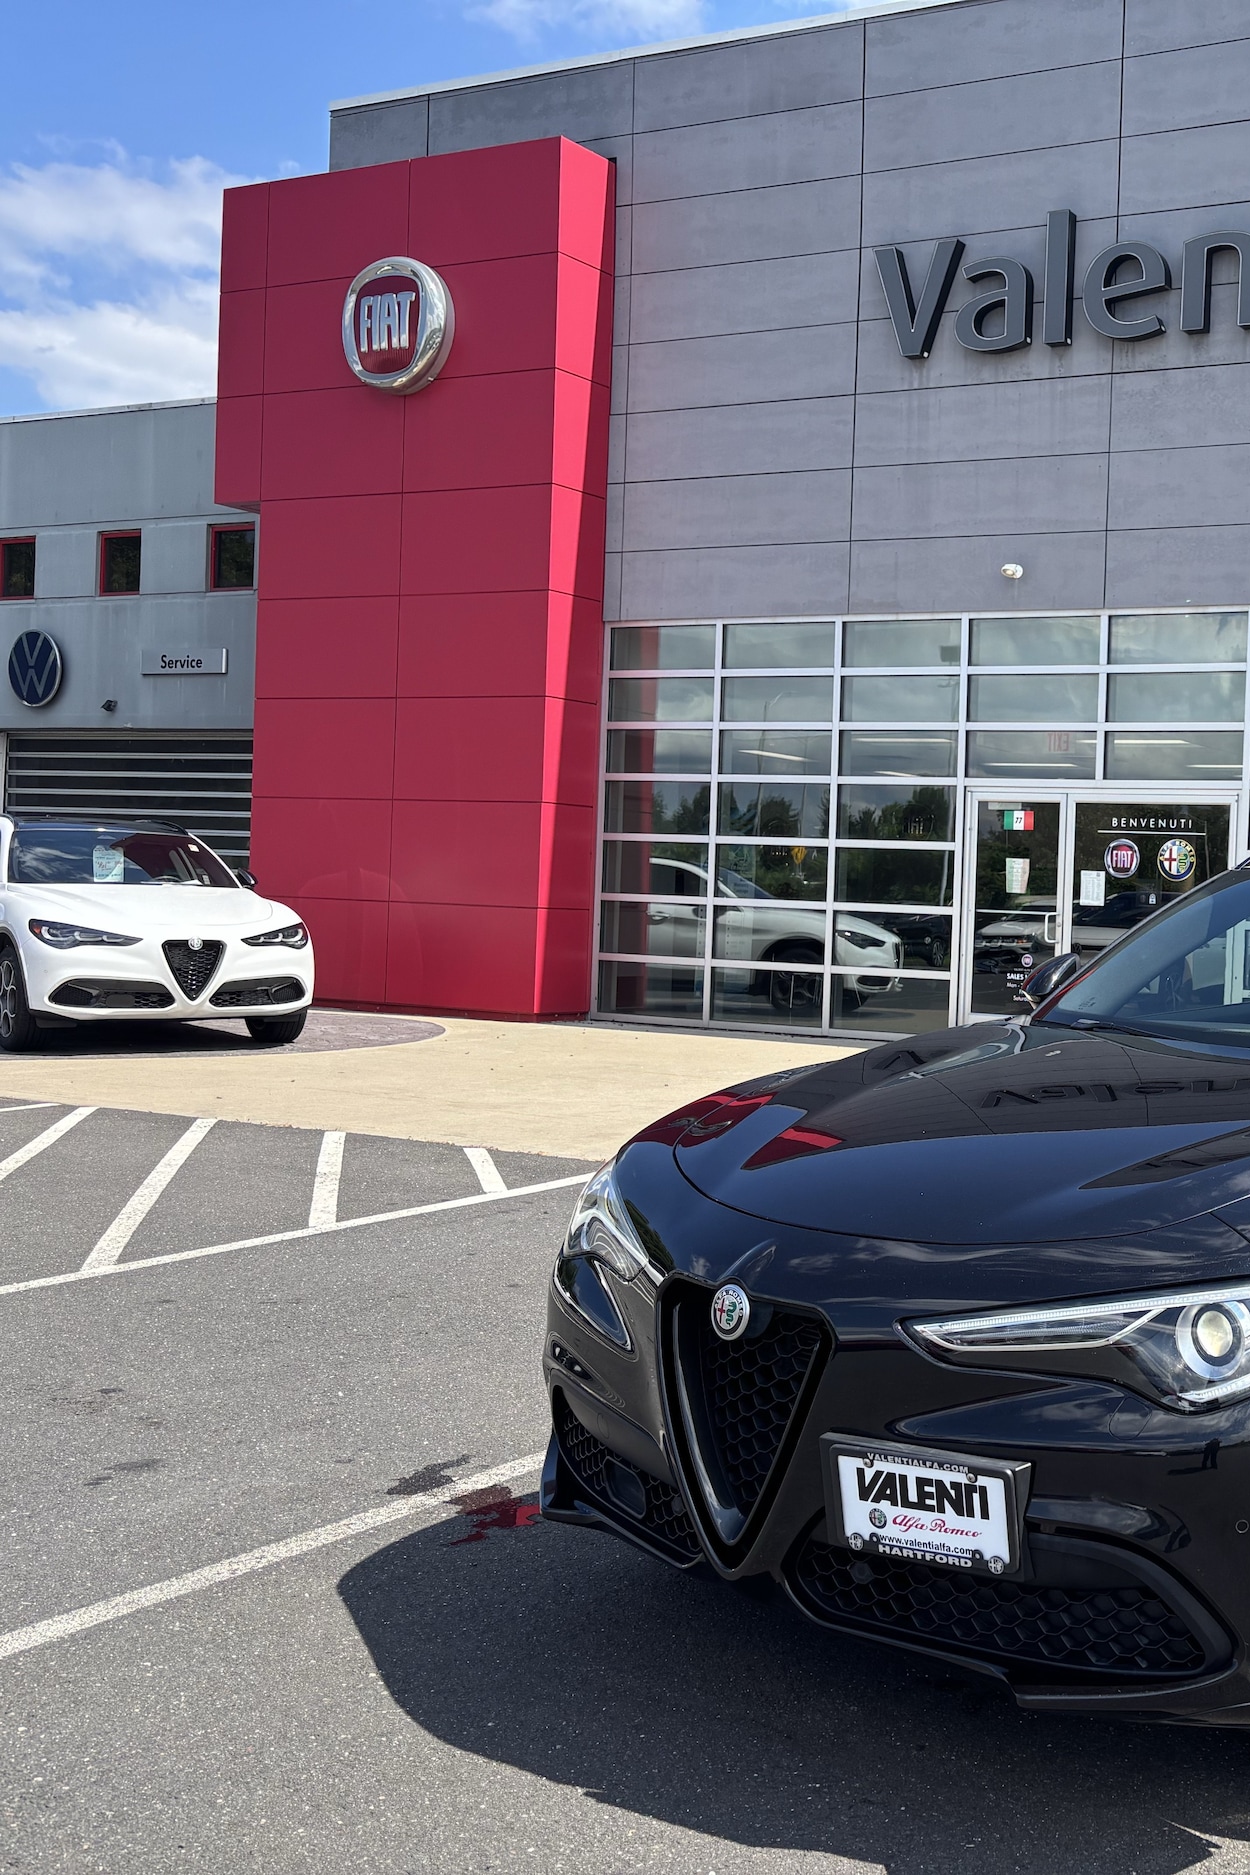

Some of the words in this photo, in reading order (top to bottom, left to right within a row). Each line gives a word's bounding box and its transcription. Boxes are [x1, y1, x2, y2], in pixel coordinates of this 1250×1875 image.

[360, 291, 416, 353] FIAT
[160, 654, 203, 669] Service
[1111, 817, 1192, 829] BENVENUTI
[1112, 850, 1133, 868] FIAT
[1006, 973, 1024, 981] SALES
[866, 1452, 969, 1474] VALENTIALFA.COM
[856, 1467, 990, 1521] VALENTI
[892, 1514, 928, 1533] Alfa
[929, 1518, 983, 1538] Romeo
[878, 1544, 973, 1568] HARTFORD
[879, 1534, 973, 1556] www.valentialfa.com
